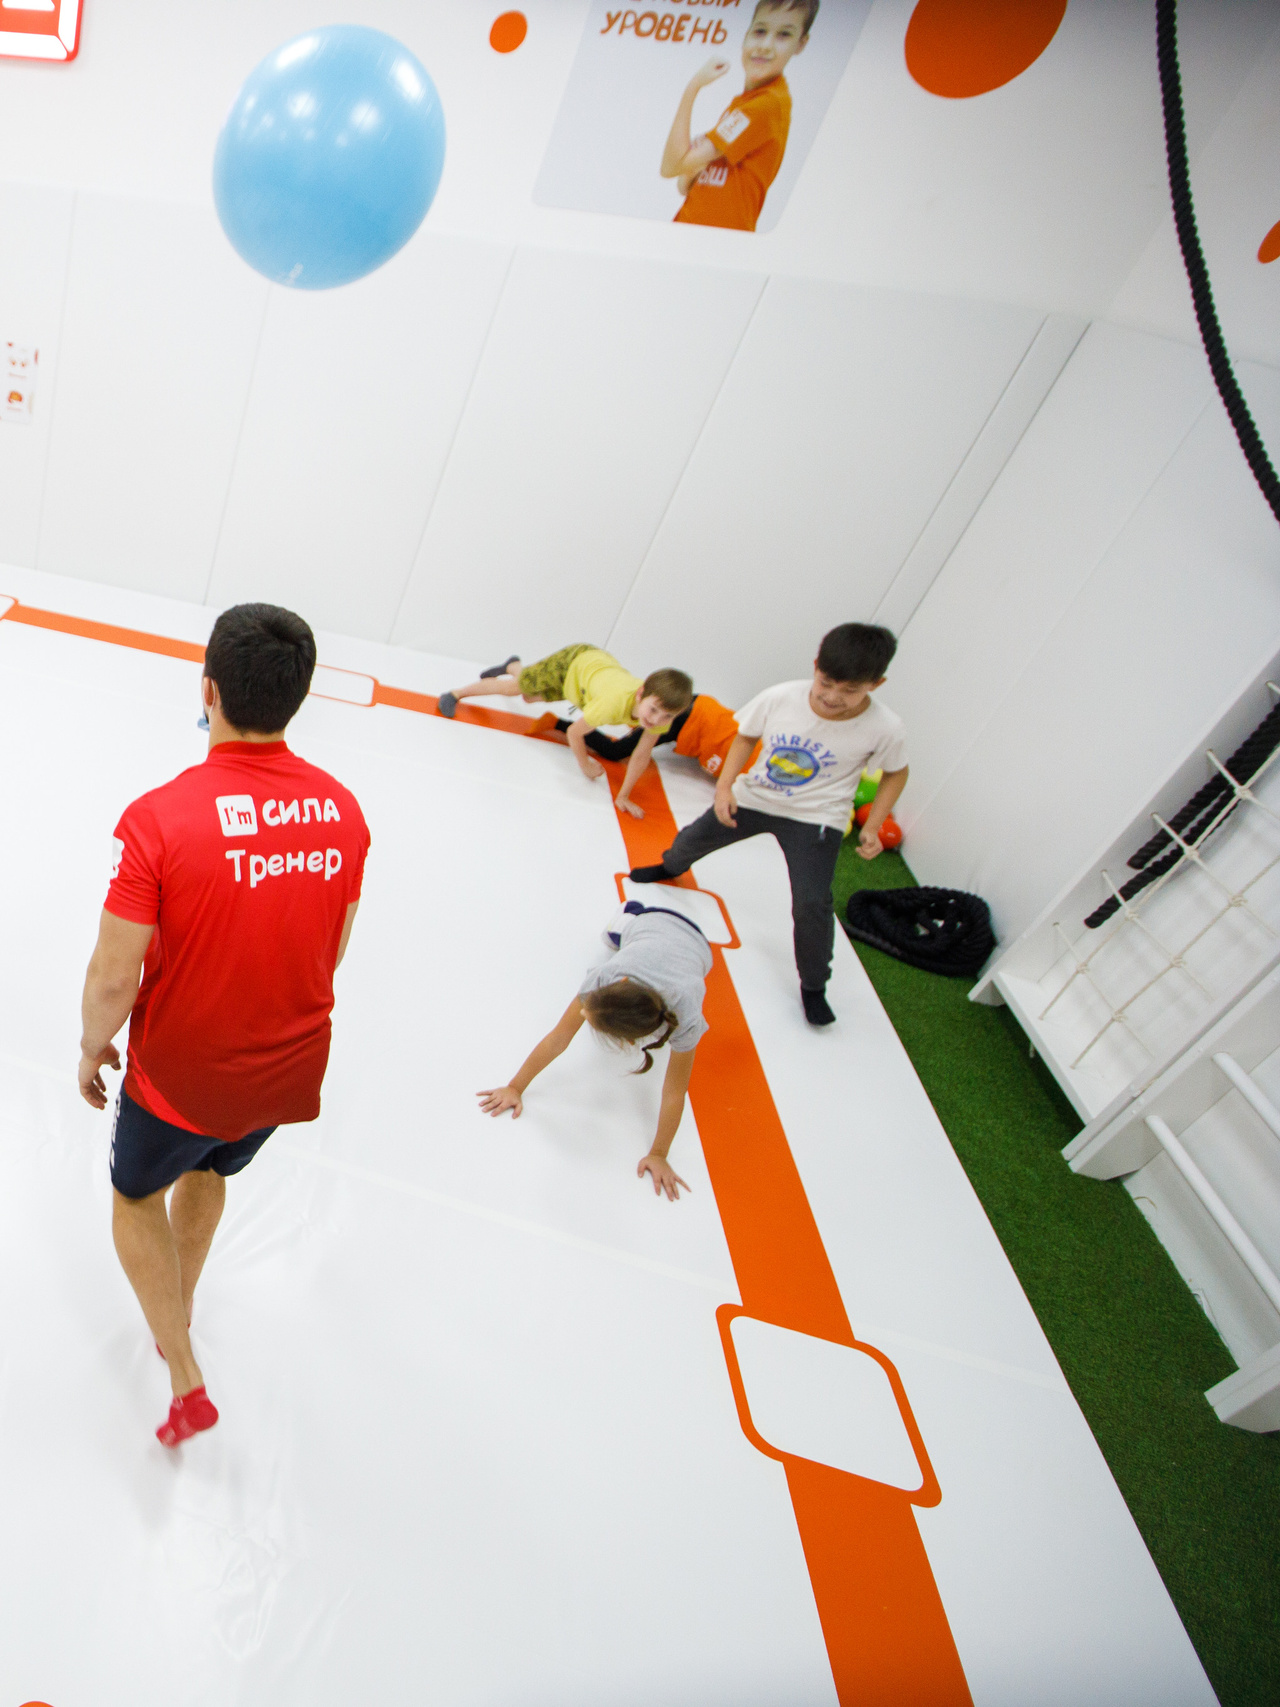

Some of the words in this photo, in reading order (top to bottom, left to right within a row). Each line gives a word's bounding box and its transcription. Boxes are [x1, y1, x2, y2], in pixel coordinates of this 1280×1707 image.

[600, 10, 728, 45] УРОВЕНЬ
[222, 805, 254, 826] I'm
[225, 848, 343, 888] Тренер
